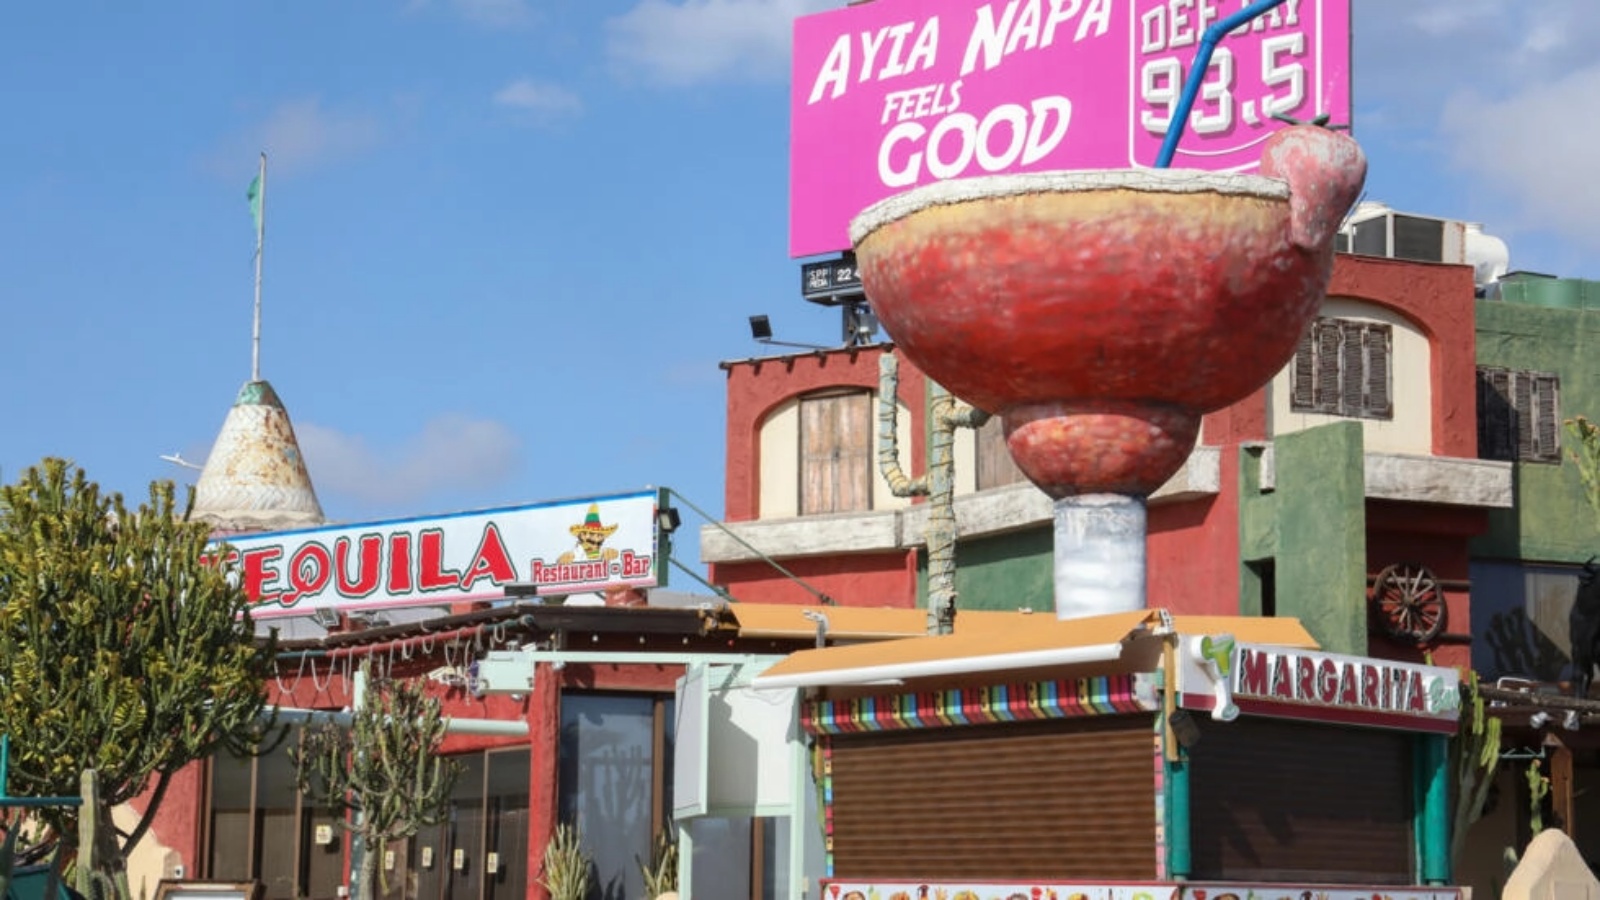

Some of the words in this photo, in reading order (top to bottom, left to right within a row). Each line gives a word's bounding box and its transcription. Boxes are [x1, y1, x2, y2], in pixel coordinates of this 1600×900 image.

[807, 15, 939, 105] AYIA
[959, 0, 1112, 77] NAPA
[1141, 32, 1304, 133] 93.5
[881, 80, 963, 125] FEELS
[878, 95, 1072, 187] GOOD
[837, 267, 852, 281] 22
[532, 558, 608, 585] Restaurant
[621, 550, 651, 578] Bar
[1240, 648, 1425, 712] MARGARITA
